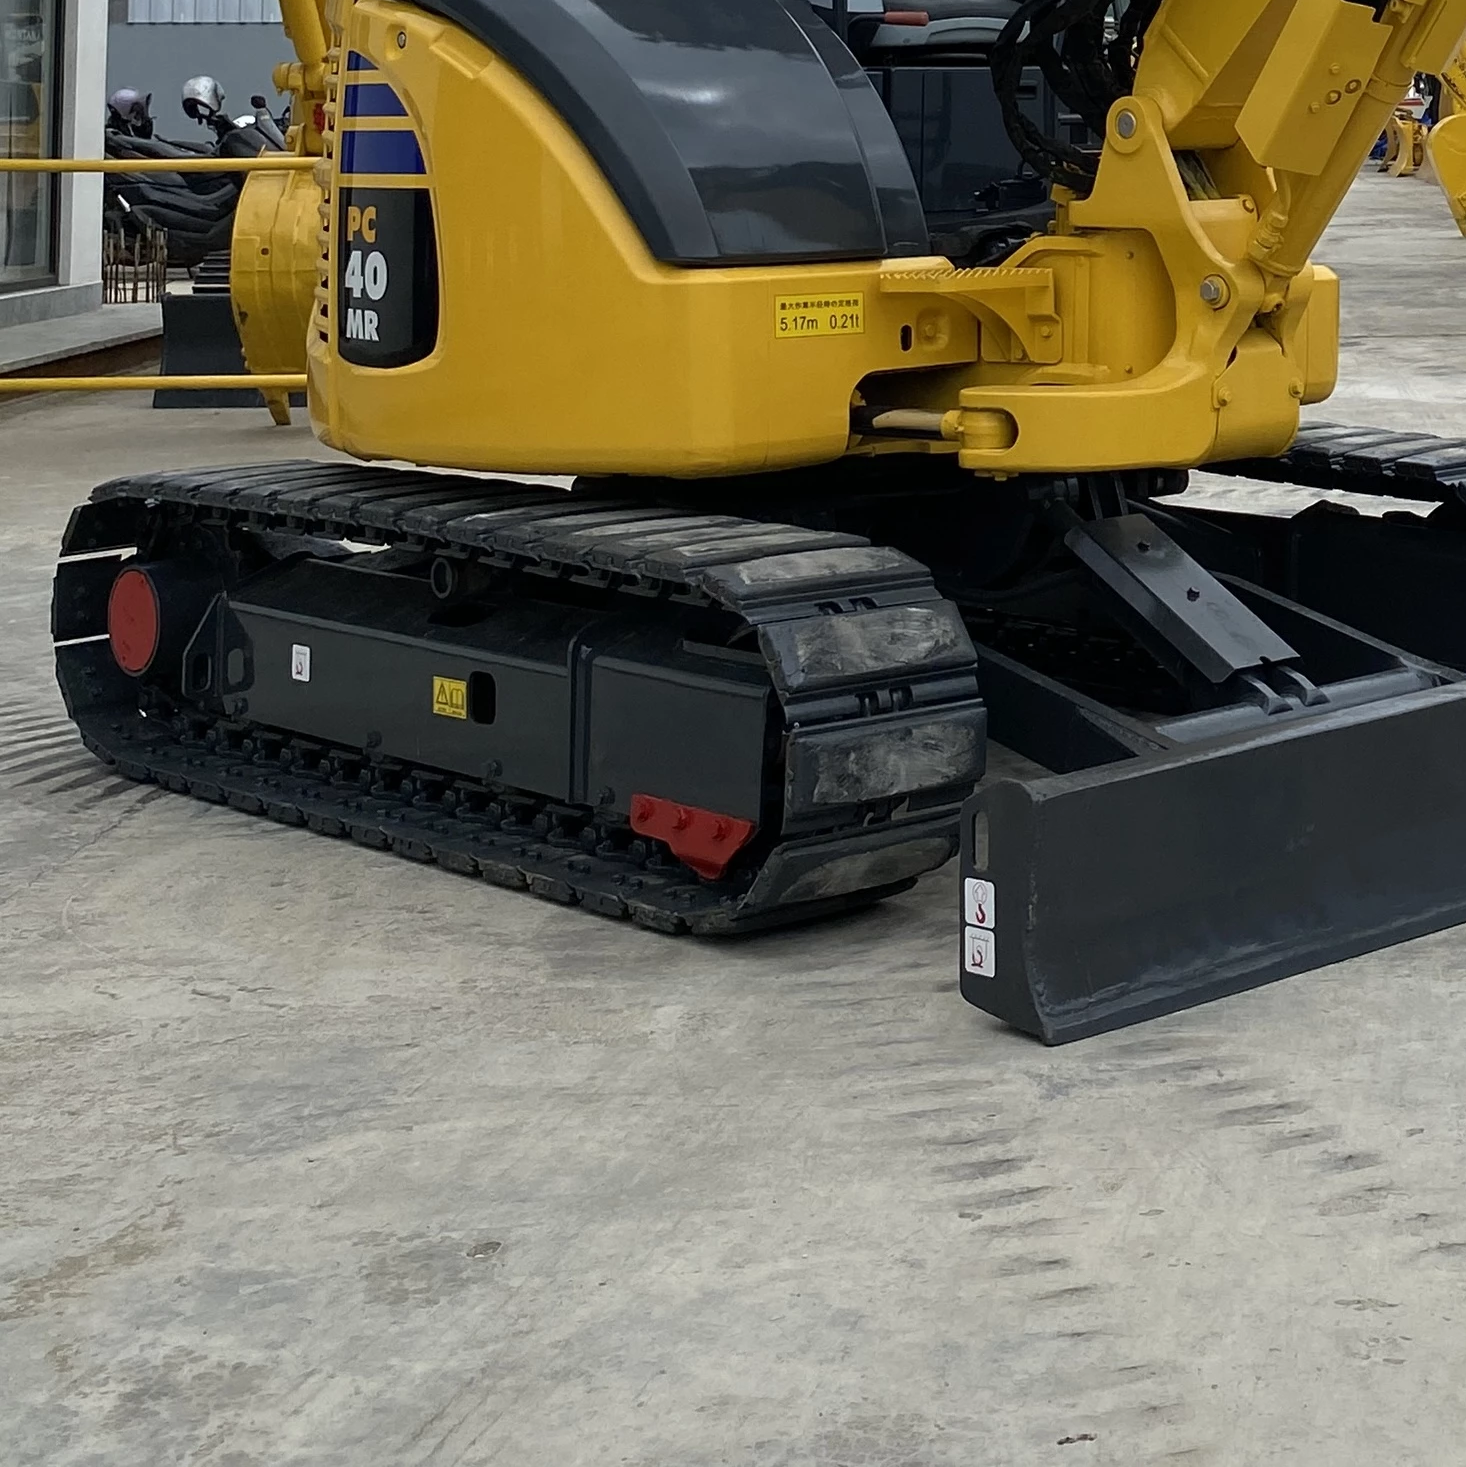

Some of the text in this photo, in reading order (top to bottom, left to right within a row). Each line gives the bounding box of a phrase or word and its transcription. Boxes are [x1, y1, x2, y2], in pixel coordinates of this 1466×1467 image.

[347, 205, 378, 244] PC
[344, 250, 388, 301] 40
[346, 308, 380, 342] MR
[780, 314, 859, 331] 5.17m 0.21t
